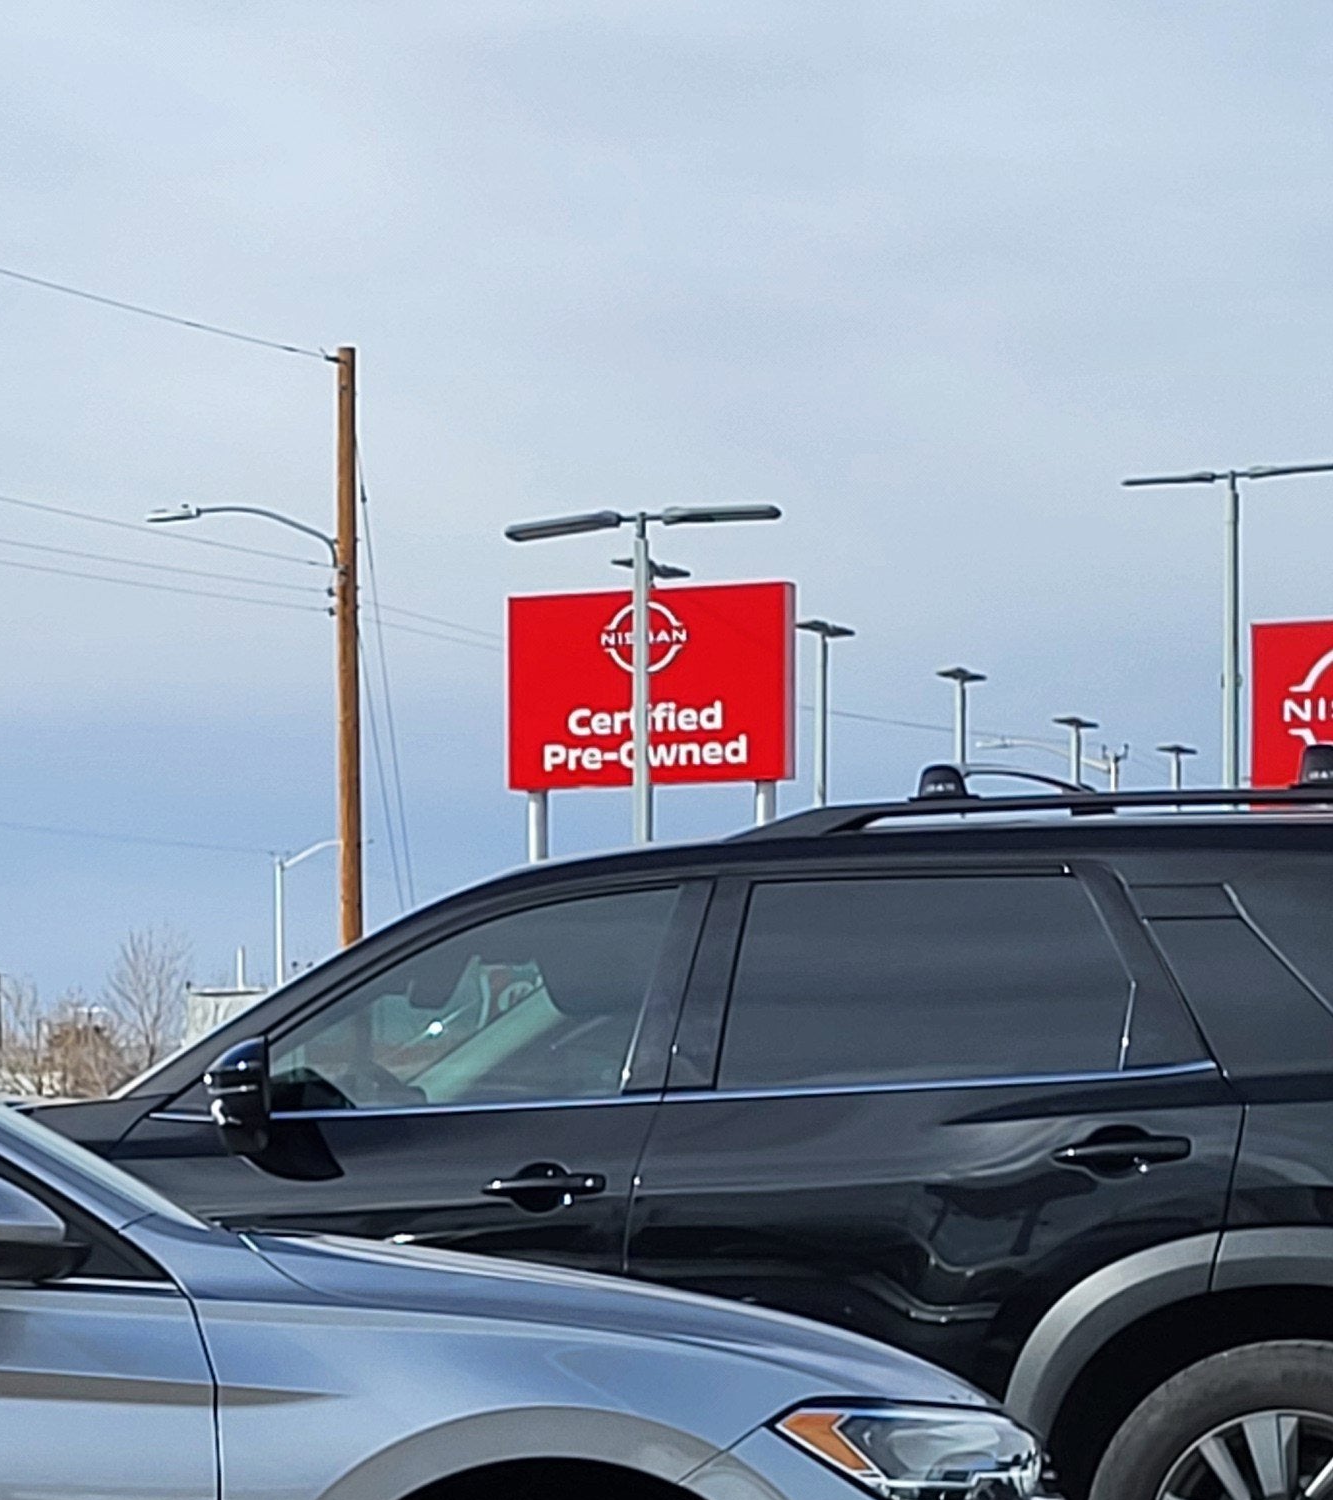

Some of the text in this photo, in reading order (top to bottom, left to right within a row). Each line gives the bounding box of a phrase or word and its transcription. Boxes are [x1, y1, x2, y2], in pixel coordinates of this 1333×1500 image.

[567, 699, 723, 737] Cerified
[1283, 697, 1333, 722] NI
[543, 733, 748, 773] Pre-Owned
